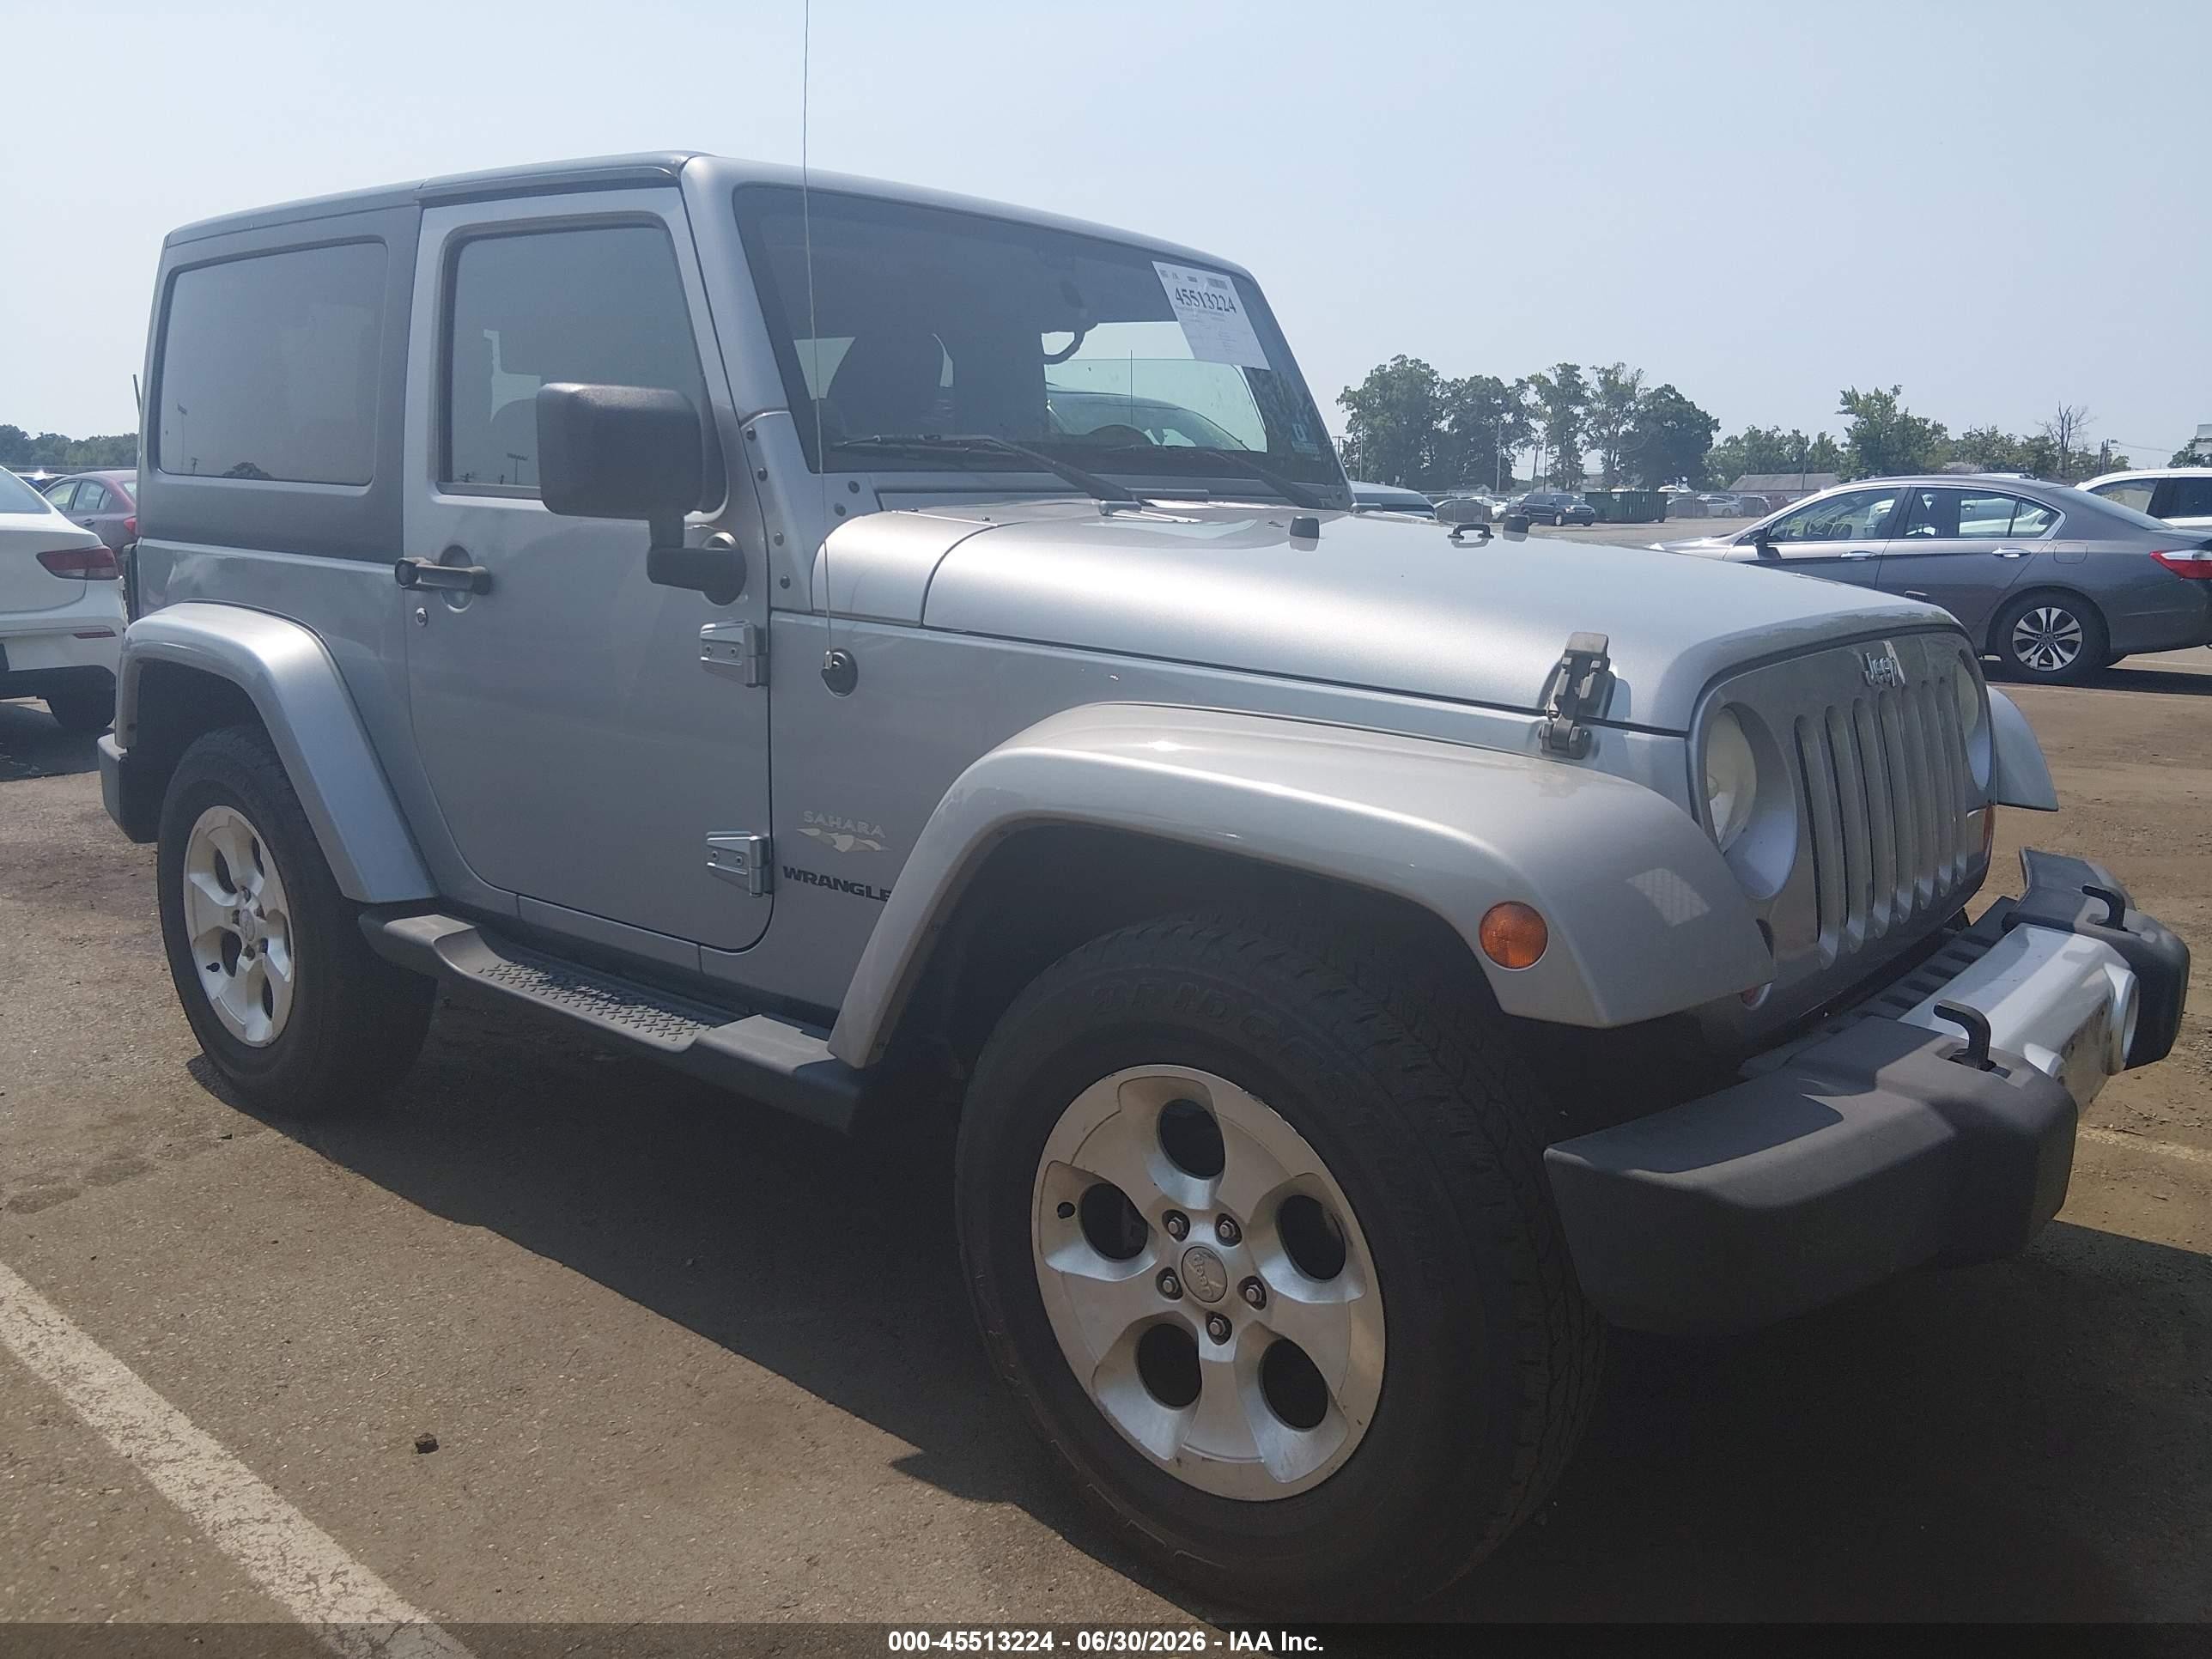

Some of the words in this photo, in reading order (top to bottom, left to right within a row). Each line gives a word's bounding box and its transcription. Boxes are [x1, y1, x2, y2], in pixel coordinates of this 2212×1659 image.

[1175, 288, 1237, 314] 45513224
[1863, 652, 1897, 688] Jeep
[803, 810, 886, 839] SAHARA
[782, 865, 893, 902] WRANGLE
